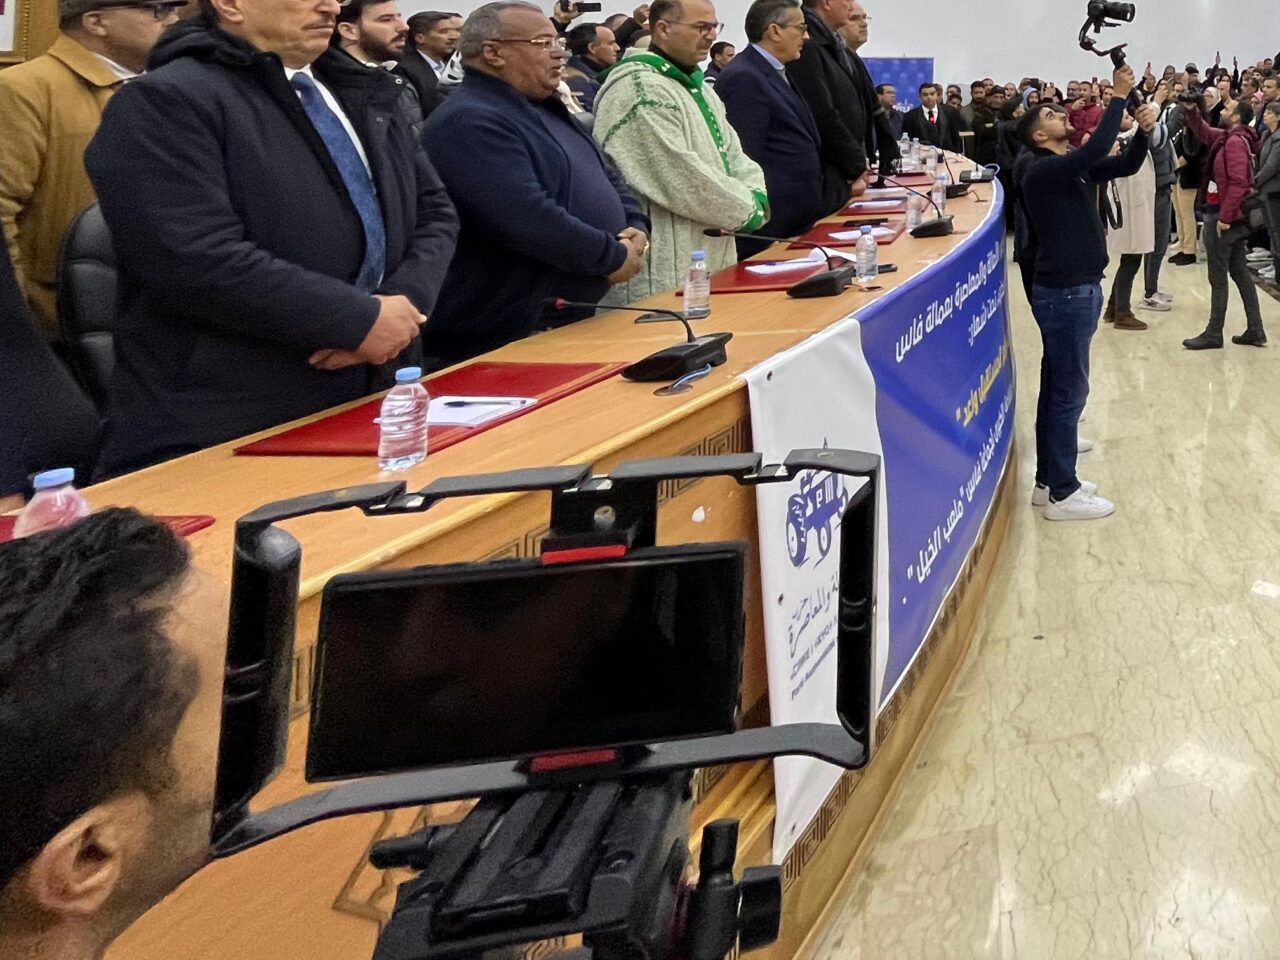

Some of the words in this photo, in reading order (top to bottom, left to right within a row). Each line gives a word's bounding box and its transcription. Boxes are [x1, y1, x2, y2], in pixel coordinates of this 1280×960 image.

[955, 261, 987, 310] والمعاصرة
[895, 313, 924, 363] فاس
[925, 294, 954, 333] بعمالة
[965, 460, 982, 503] فاس
[916, 524, 942, 584] الخيل
[788, 585, 831, 659] والمعاصرة
